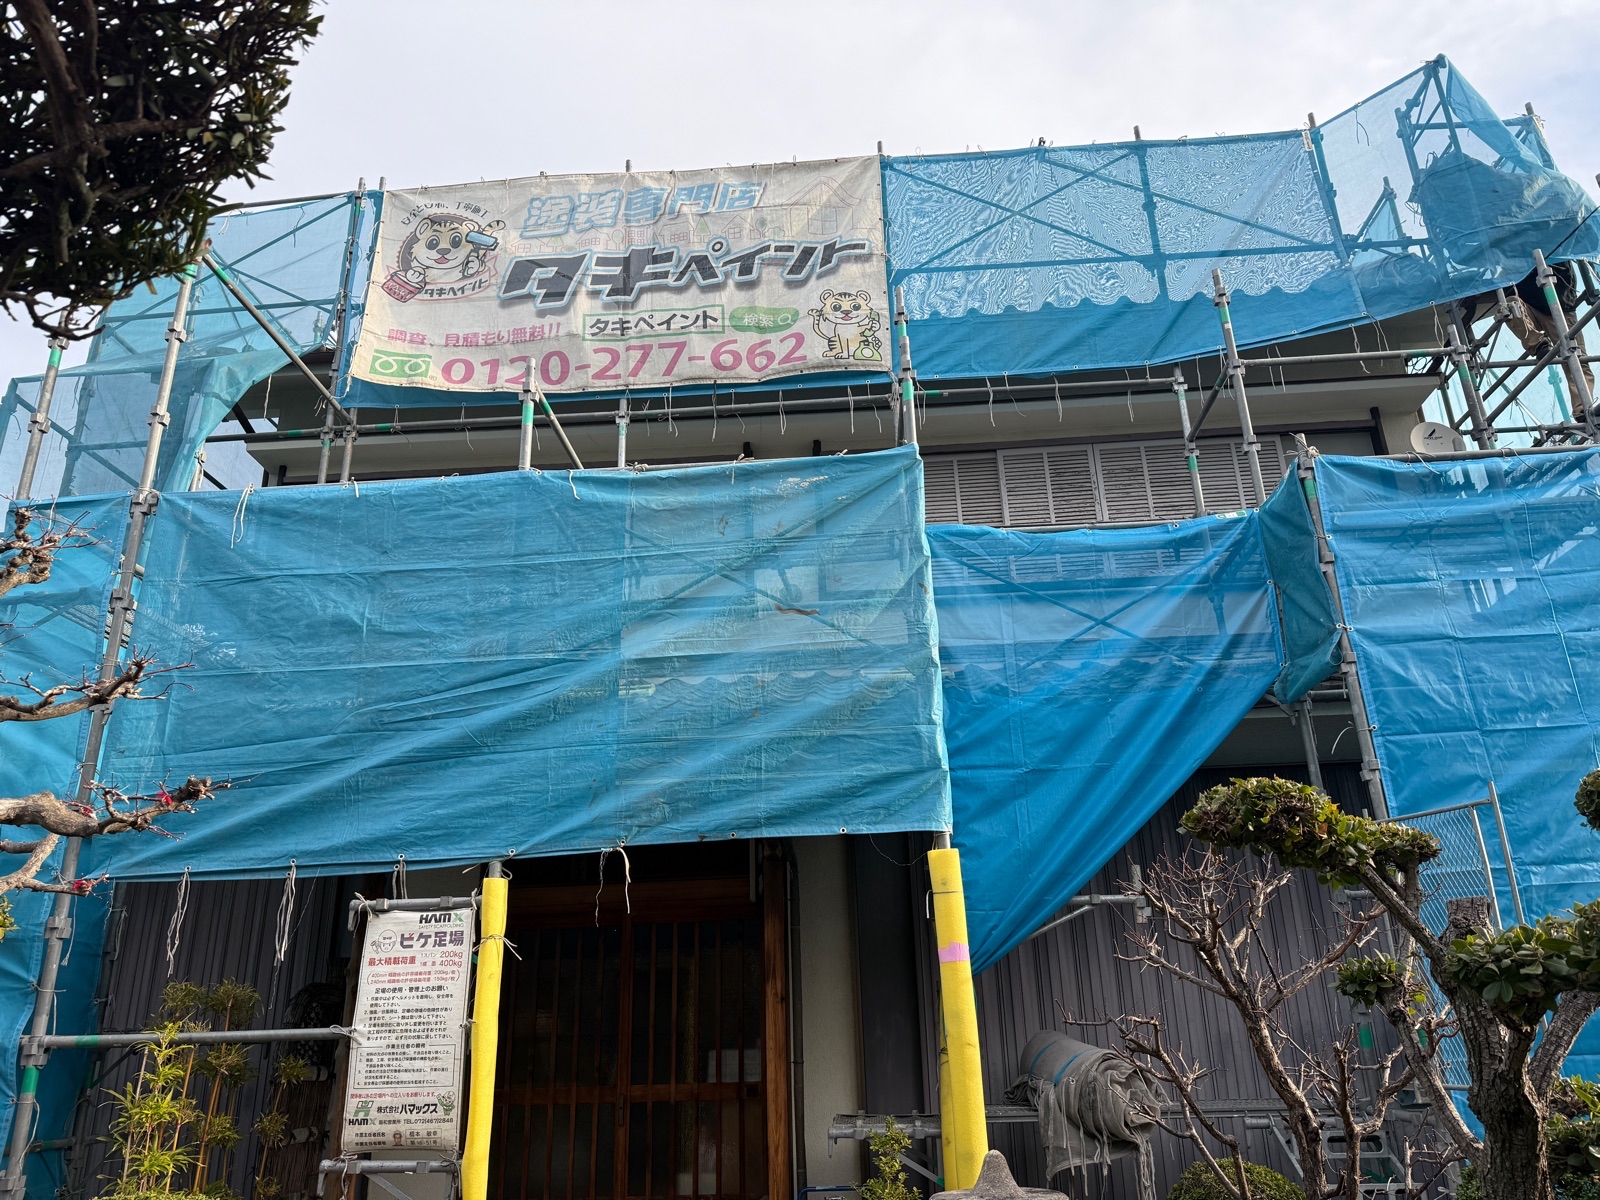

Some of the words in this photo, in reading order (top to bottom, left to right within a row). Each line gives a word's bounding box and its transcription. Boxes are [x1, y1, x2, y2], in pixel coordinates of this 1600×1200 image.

[519, 182, 763, 239] 塗装専門店
[500, 238, 869, 308] タキペイント
[589, 310, 719, 337] タキペイント
[742, 313, 775, 328] 検索
[440, 331, 808, 386] 0120-277-662
[399, 930, 465, 950] ビケ足場
[367, 956, 417, 967] 最大積載荷重
[439, 959, 463, 968] 400kg
[440, 951, 463, 960] 200kg
[376, 1103, 438, 1115] 株式会社ハマックス
